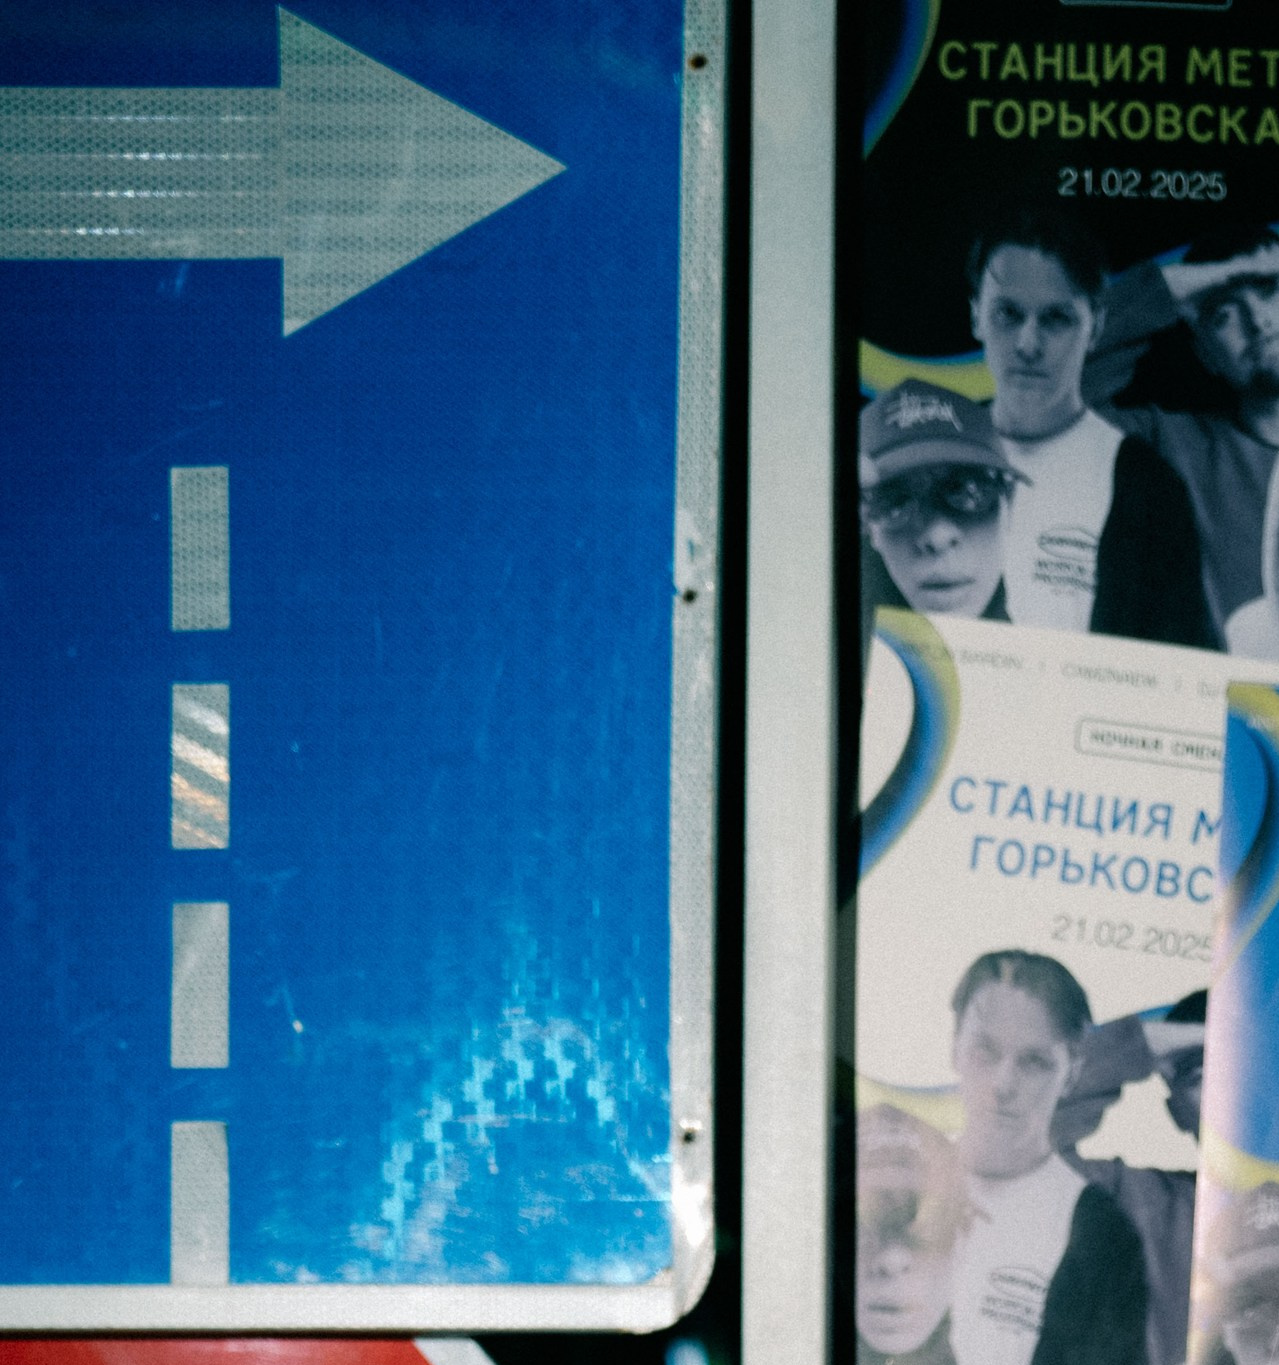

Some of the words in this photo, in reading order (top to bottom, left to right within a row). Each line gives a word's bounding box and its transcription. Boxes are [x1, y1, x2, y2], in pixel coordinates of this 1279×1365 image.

[937, 40, 1167, 87] СТАНЦИЯ
[1057, 166, 1228, 201] 21.02.2025
[950, 776, 1175, 842] СТАНЦИЯ
